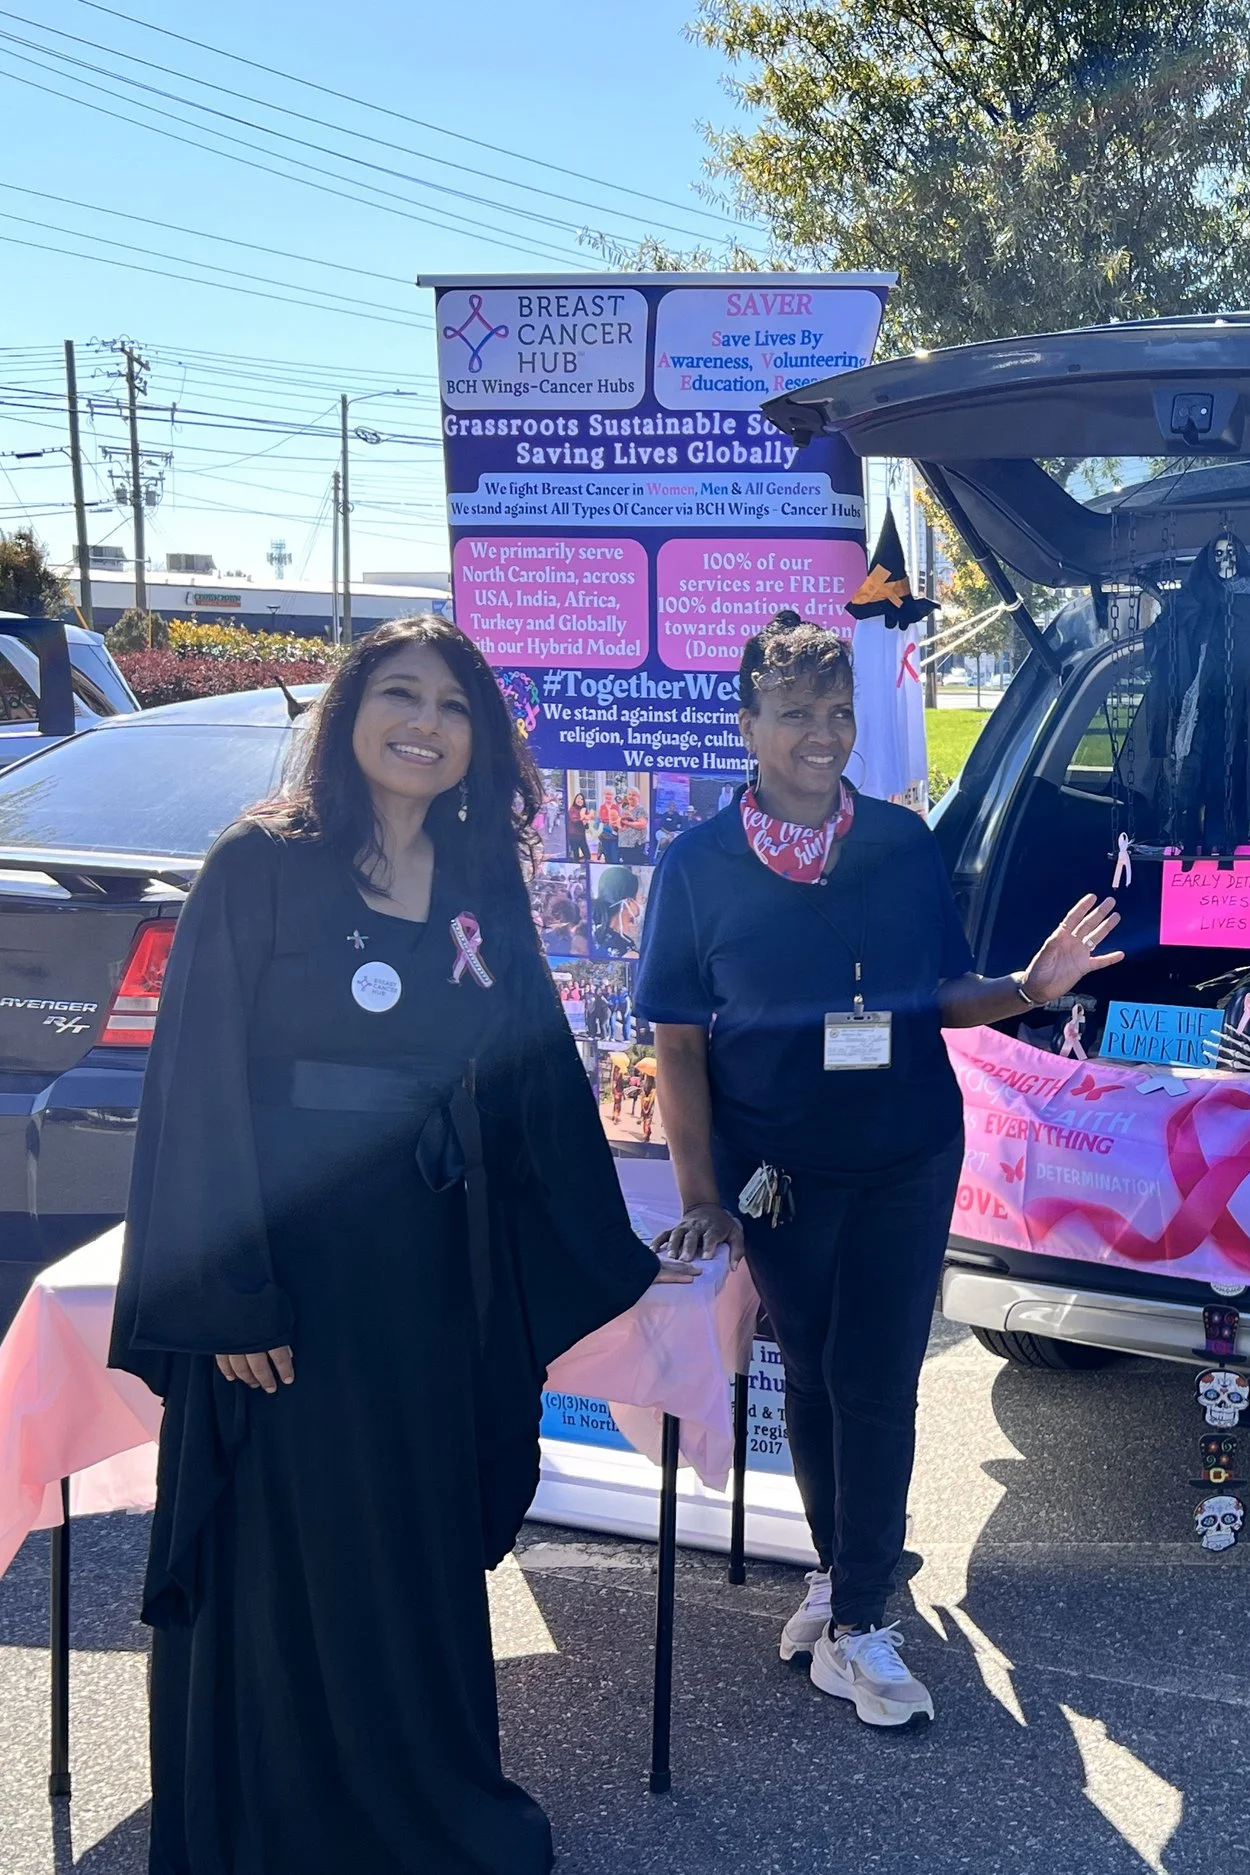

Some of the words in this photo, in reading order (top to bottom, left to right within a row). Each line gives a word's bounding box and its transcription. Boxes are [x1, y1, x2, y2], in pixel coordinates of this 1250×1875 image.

[519, 296, 625, 317] BREAST
[726, 293, 813, 317] SAVER
[517, 323, 633, 345] CANCER
[712, 331, 750, 347] Save
[755, 331, 796, 347] Lives
[801, 330, 824, 350] By
[518, 351, 578, 373] HUB
[657, 352, 753, 371] Awareness,
[446, 380, 478, 394] BCH
[481, 379, 595, 398] Wings-Cancer
[598, 378, 635, 394] Hubs
[680, 375, 769, 394] Education,
[444, 415, 580, 437] Grassroots
[589, 412, 737, 437] Sustainable
[517, 442, 604, 468] Saving
[614, 442, 678, 465] Lives
[687, 441, 799, 469] Globally
[484, 482, 508, 496] We
[509, 481, 540, 500] fight
[541, 482, 584, 497] Breast
[585, 482, 631, 497] Cancer
[632, 483, 645, 496] in
[646, 482, 698, 498] Women,
[700, 482, 729, 496] Men
[731, 482, 743, 496] &
[745, 482, 763, 496] All
[765, 482, 821, 497] Genders
[451, 502, 473, 516] We
[473, 502, 502, 517] stand
[504, 502, 548, 521] against
[550, 502, 570, 516] All
[572, 502, 610, 520] Types
[613, 502, 631, 517] Of
[632, 502, 675, 517] Cancer
[675, 503, 694, 517] via
[695, 503, 725, 517] BCH
[727, 503, 770, 521] Wings
[780, 502, 829, 518] Cancer
[831, 503, 861, 519] Hubs
[470, 543, 497, 560] We
[500, 543, 574, 566] primarily
[580, 547, 624, 561] serve
[702, 552, 752, 571] 100%
[757, 553, 775, 571] of
[777, 556, 813, 571] our
[462, 566, 505, 583] North
[508, 566, 580, 586] Carolina,
[583, 571, 636, 585] across
[679, 576, 751, 593] services
[755, 579, 786, 593] are
[789, 577, 846, 594] FREE
[474, 590, 513, 609] USA,
[515, 590, 561, 610] India,
[564, 591, 621, 612] Africa,
[658, 597, 705, 614] 100%
[470, 614, 523, 634] Turkey
[525, 614, 554, 631] and
[558, 615, 626, 637] Globally
[665, 619, 736, 637] towards
[473, 636, 495, 653] ith
[497, 641, 524, 654] our
[526, 637, 583, 660] Hybrid
[587, 639, 641, 658] Model
[543, 703, 571, 720] We
[573, 704, 618, 722] stand
[620, 704, 678, 727] against
[559, 727, 624, 747] religion,
[627, 729, 701, 750] language,
[624, 751, 655, 768] We
[657, 755, 699, 769] serve
[1171, 873, 1220, 888] EARLY
[1200, 895, 1249, 908] SAVES
[1200, 918, 1248, 930] LIVES
[0, 997, 98, 1012] AVENGER
[42, 1015, 91, 1034] R/T
[1120, 1007, 1172, 1033] SAVE
[1177, 1010, 1210, 1037] THE
[984, 1113, 1114, 1155] EVERYTHING
[1036, 1162, 1161, 1198] DETERMINATION
[956, 1184, 1008, 1220] OVE
[563, 1411, 576, 1426] in
[762, 1406, 773, 1420] &
[750, 1439, 783, 1455] 2017
